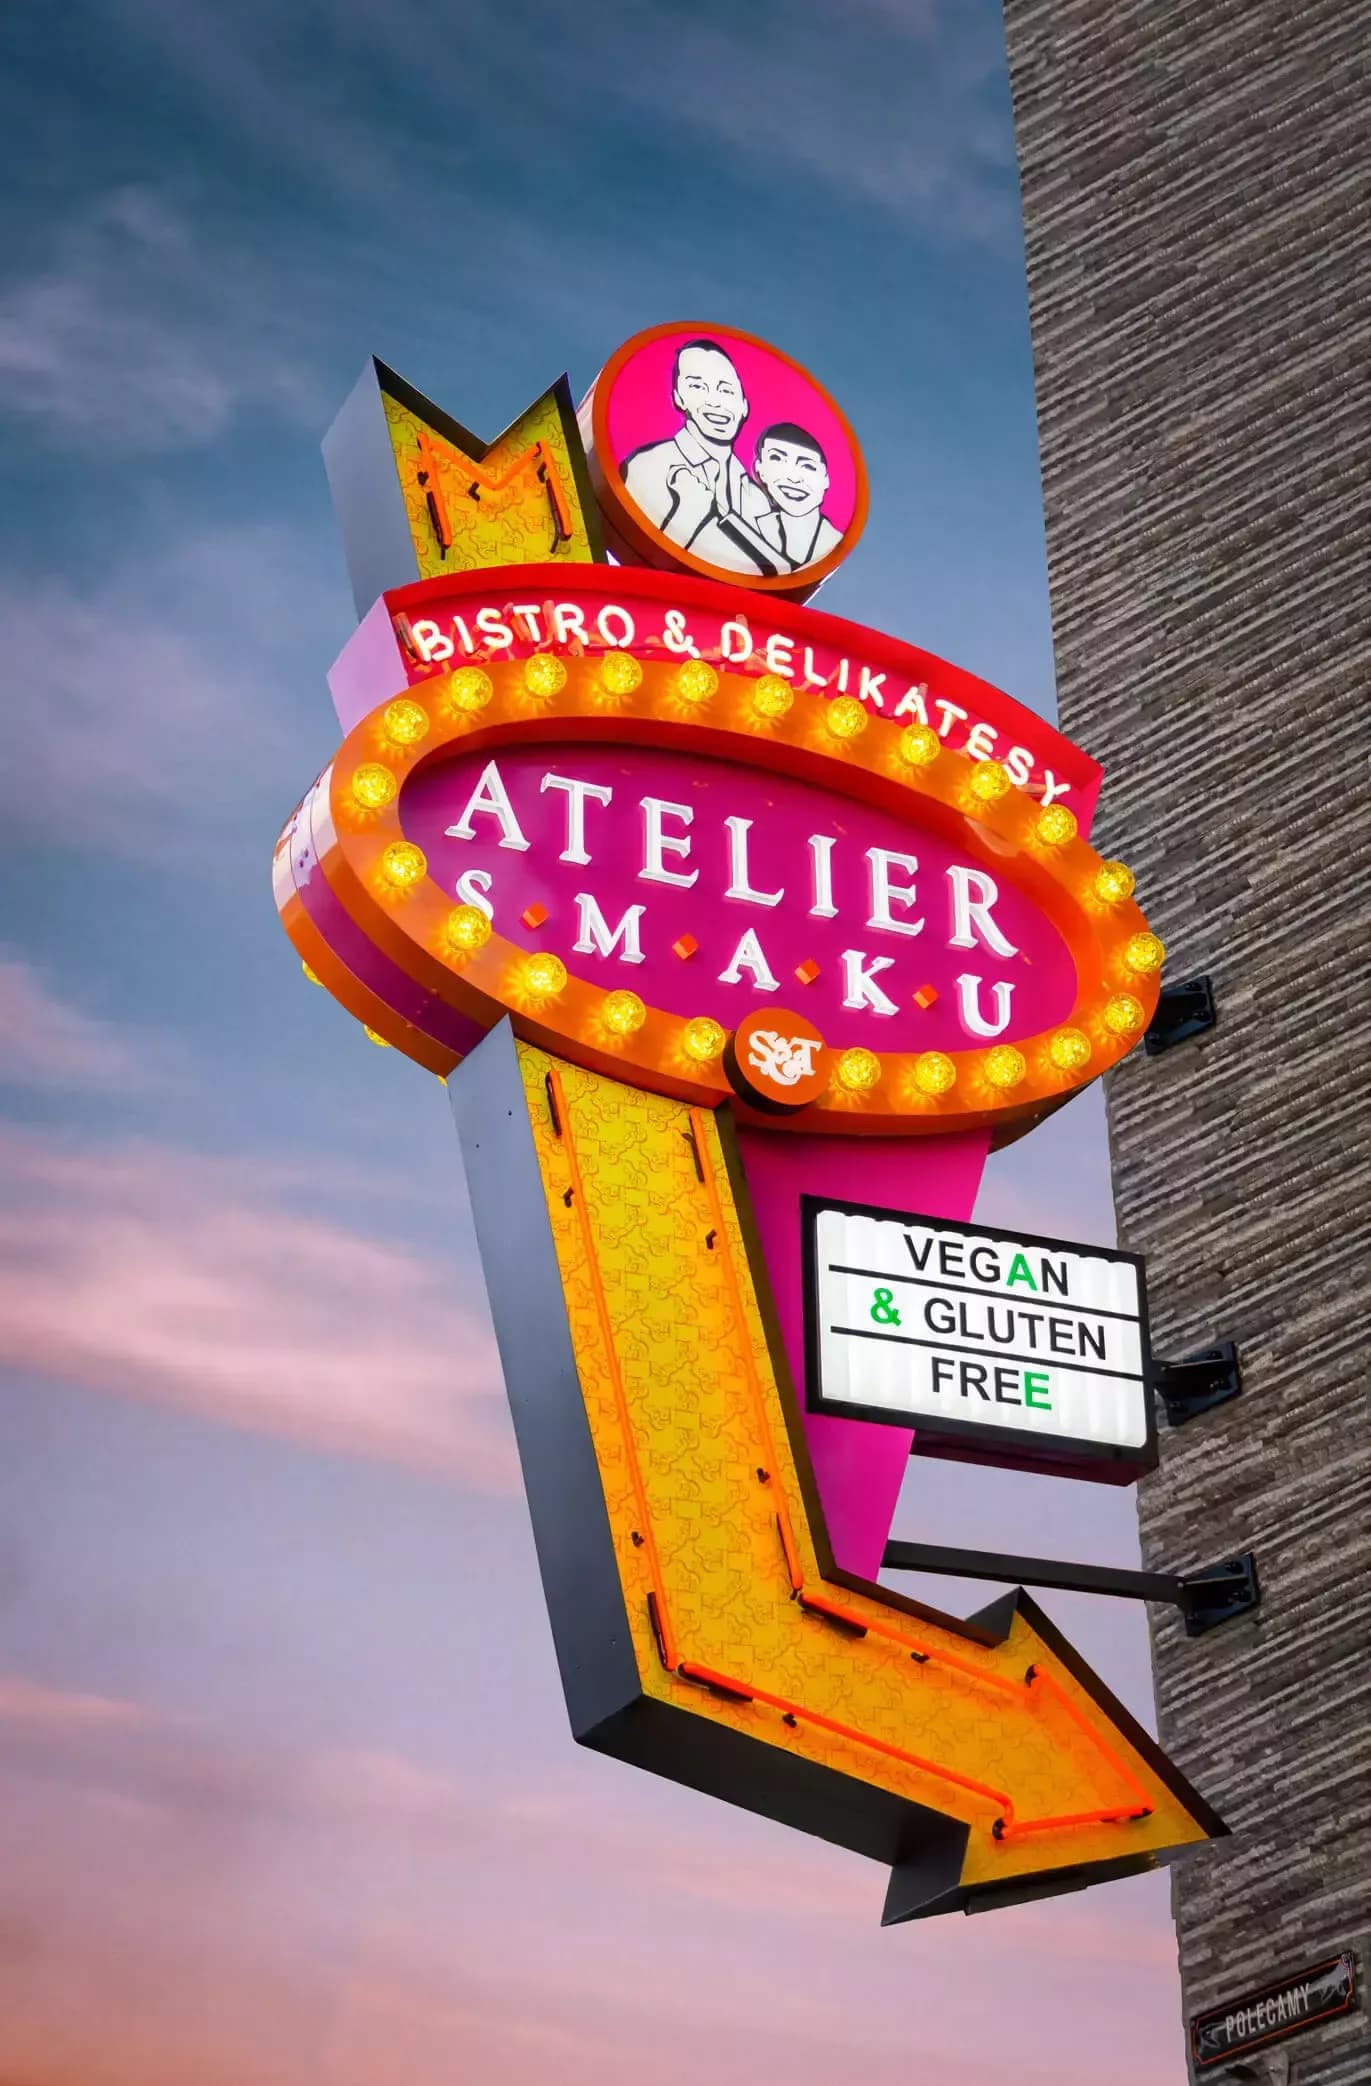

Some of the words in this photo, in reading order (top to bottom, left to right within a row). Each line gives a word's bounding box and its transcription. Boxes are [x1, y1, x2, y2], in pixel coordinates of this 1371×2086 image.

[411, 603, 635, 662] BISTRO
[662, 609, 701, 659] &
[445, 759, 1019, 958] ATELIER
[904, 1234, 1069, 1297] VEGAN
[870, 1287, 901, 1326] &
[924, 1298, 1106, 1360] GLUTEN
[931, 1356, 1052, 1410] FREE
[1225, 1983, 1311, 2043] POLECAMY
